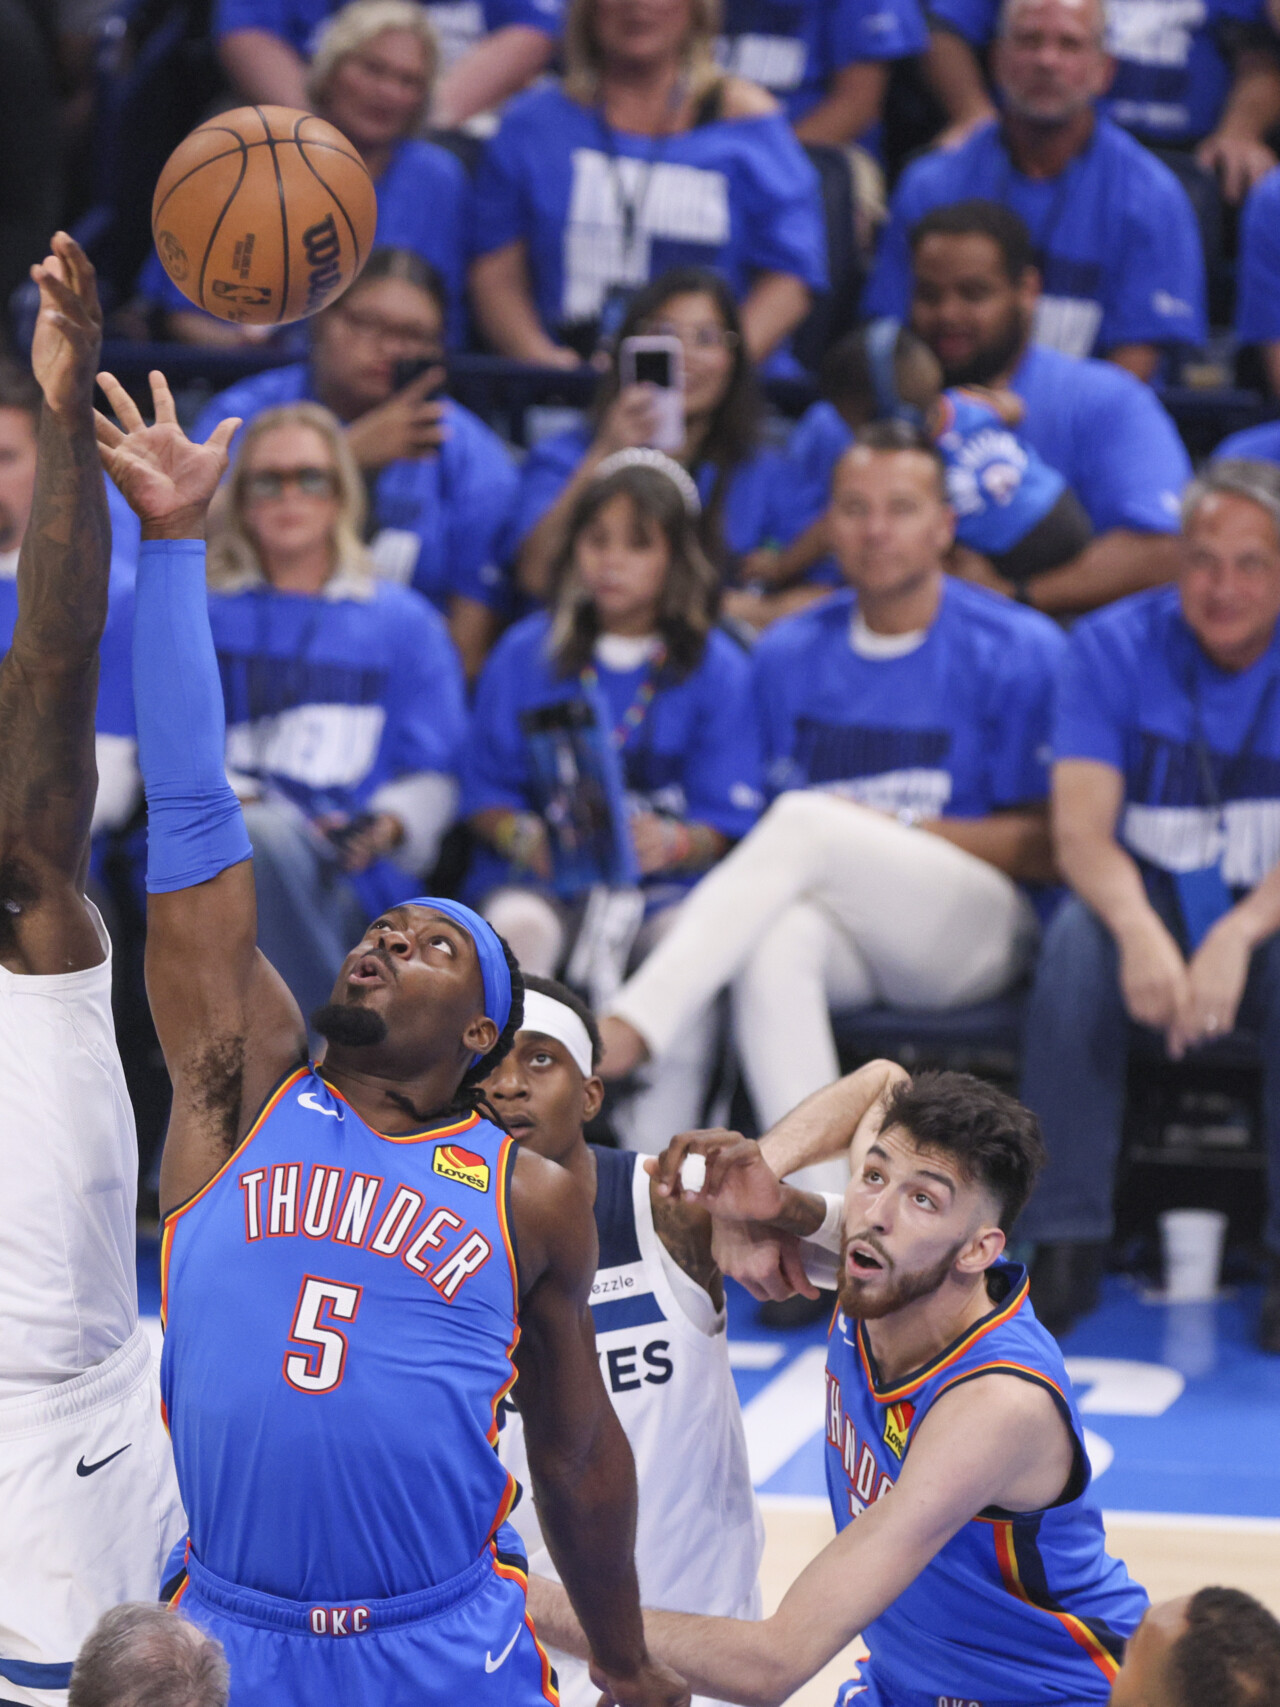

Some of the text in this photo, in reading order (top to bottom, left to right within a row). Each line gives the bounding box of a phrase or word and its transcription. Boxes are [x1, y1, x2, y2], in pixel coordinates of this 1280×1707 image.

[239, 1162, 493, 1305] THUNDER
[591, 1275, 634, 1295] ezzle
[282, 1274, 363, 1395] 5
[310, 1606, 370, 1636] OKC
